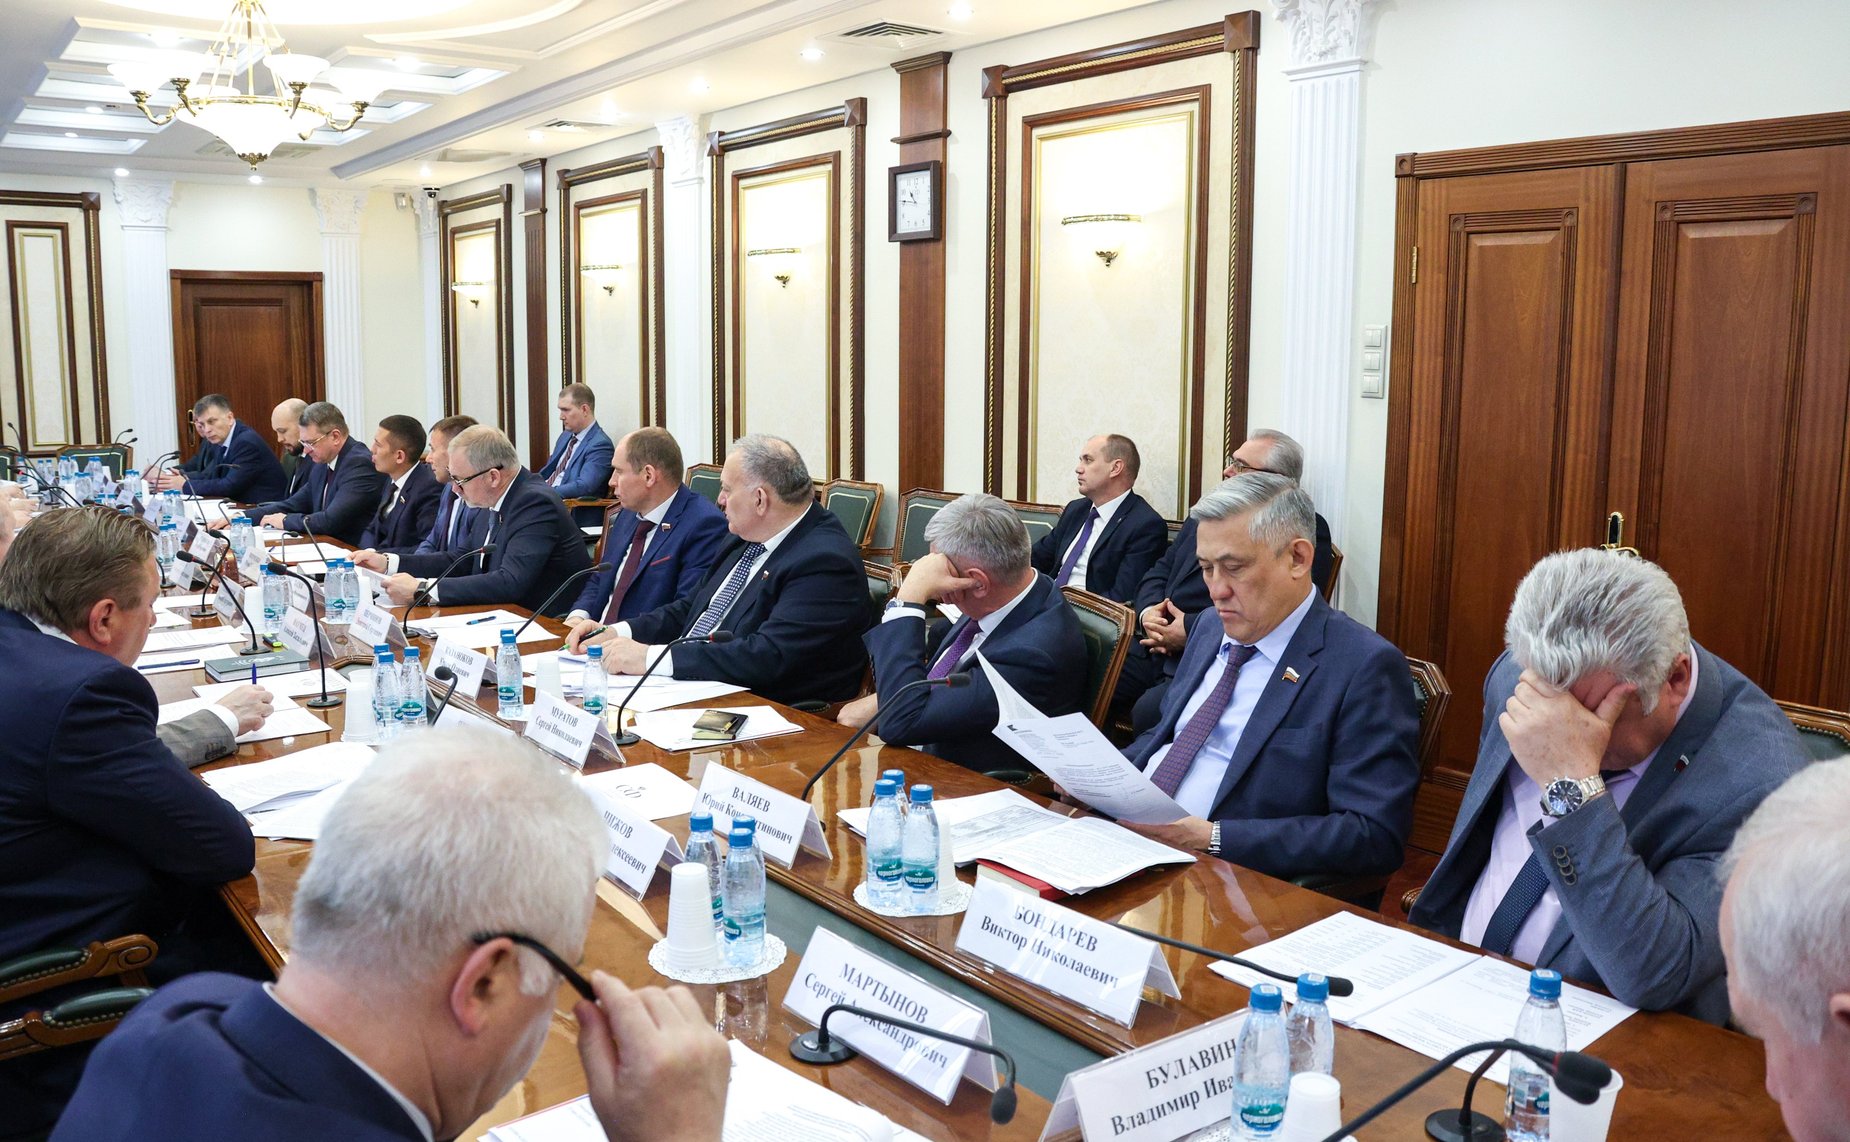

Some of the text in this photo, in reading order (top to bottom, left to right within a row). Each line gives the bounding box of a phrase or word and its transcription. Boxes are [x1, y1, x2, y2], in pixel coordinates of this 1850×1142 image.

[535, 715, 583, 749] Сергей Николаевич
[551, 706, 579, 728] МУРАТОВ
[701, 792, 725, 812] Юрий
[732, 786, 771, 813] ВАЛЯЕВ
[610, 843, 647, 875] лексеевич
[1014, 905, 1099, 952] БОНДАРЕВ
[980, 915, 1119, 989] Виктор Николаевич
[805, 972, 846, 1006] Сергей
[839, 963, 928, 1024] МАРТЫНОВ
[1145, 1038, 1236, 1090] БУЛАВИН
[1111, 1075, 1234, 1136] Владимир Ива
